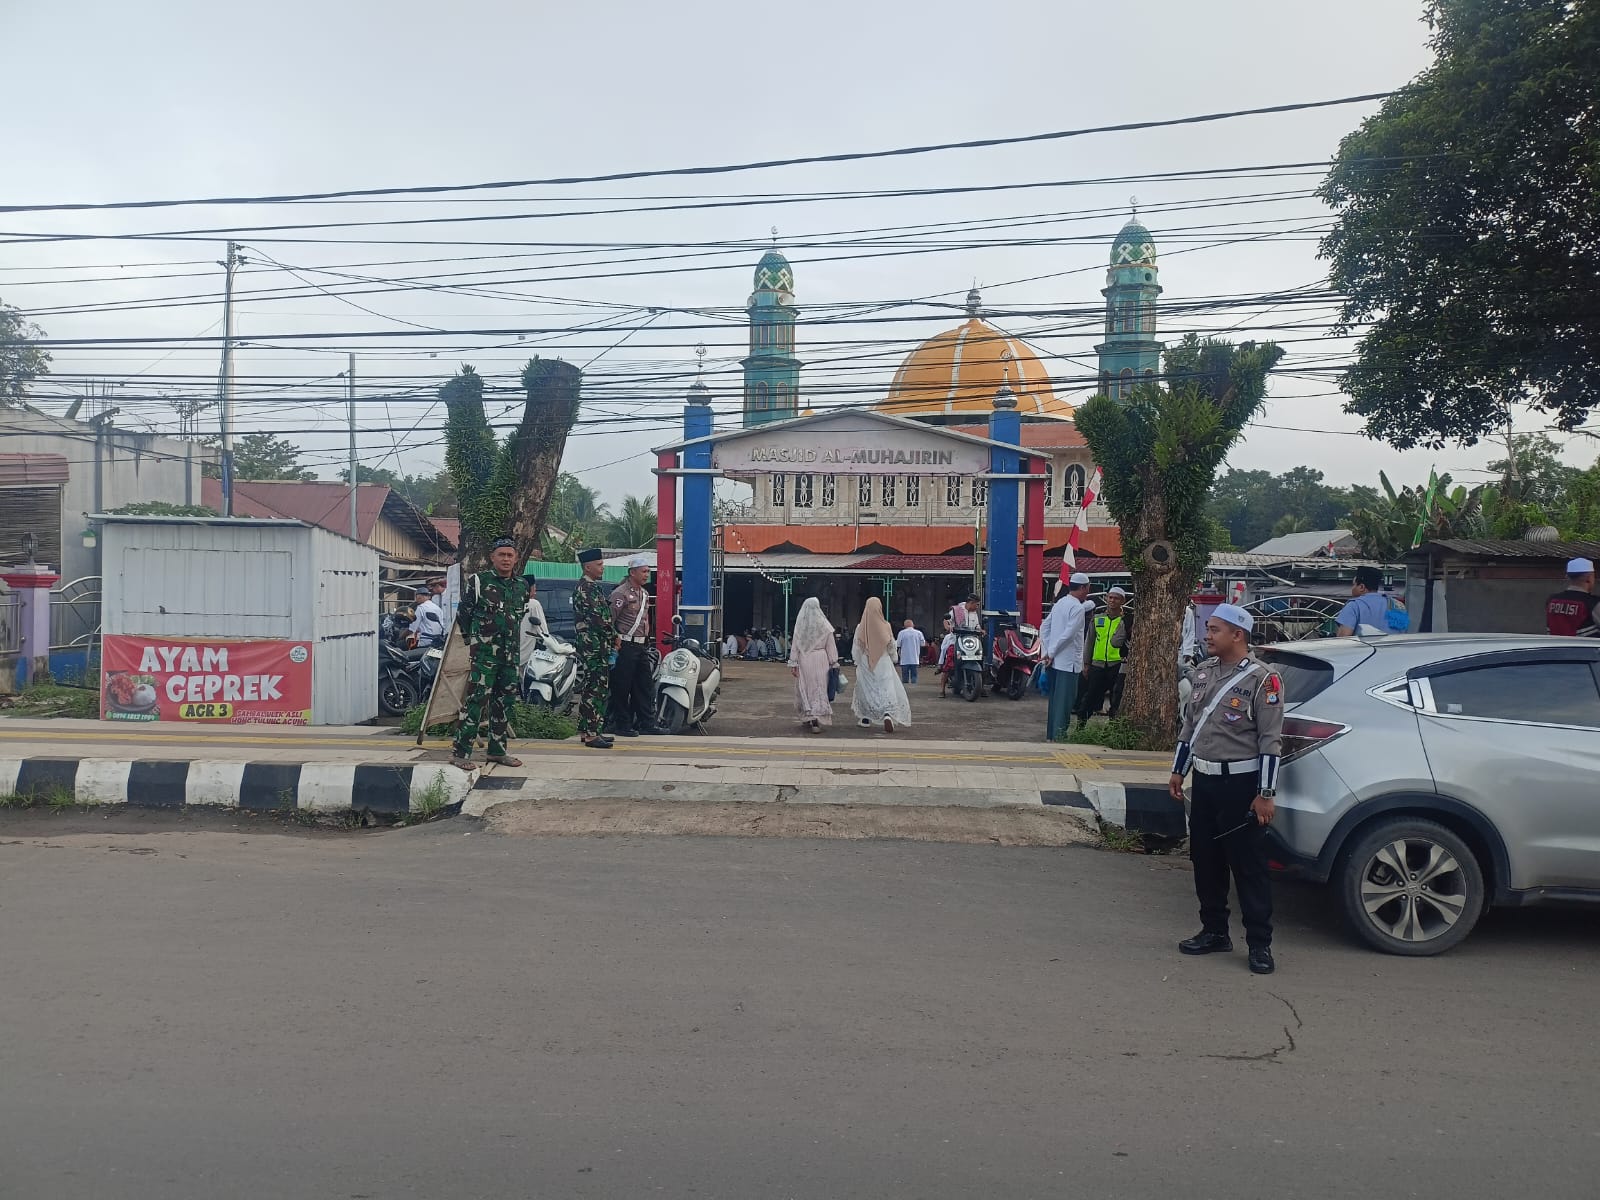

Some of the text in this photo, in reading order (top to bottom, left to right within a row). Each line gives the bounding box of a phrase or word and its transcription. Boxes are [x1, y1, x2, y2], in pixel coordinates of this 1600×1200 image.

[751, 448, 952, 465] MASJID AL-MUHAJIRIN
[1549, 602, 1579, 616] POLISI
[138, 646, 229, 673] AYAM
[165, 674, 284, 703] GEPREK
[185, 704, 228, 718] AGR 3
